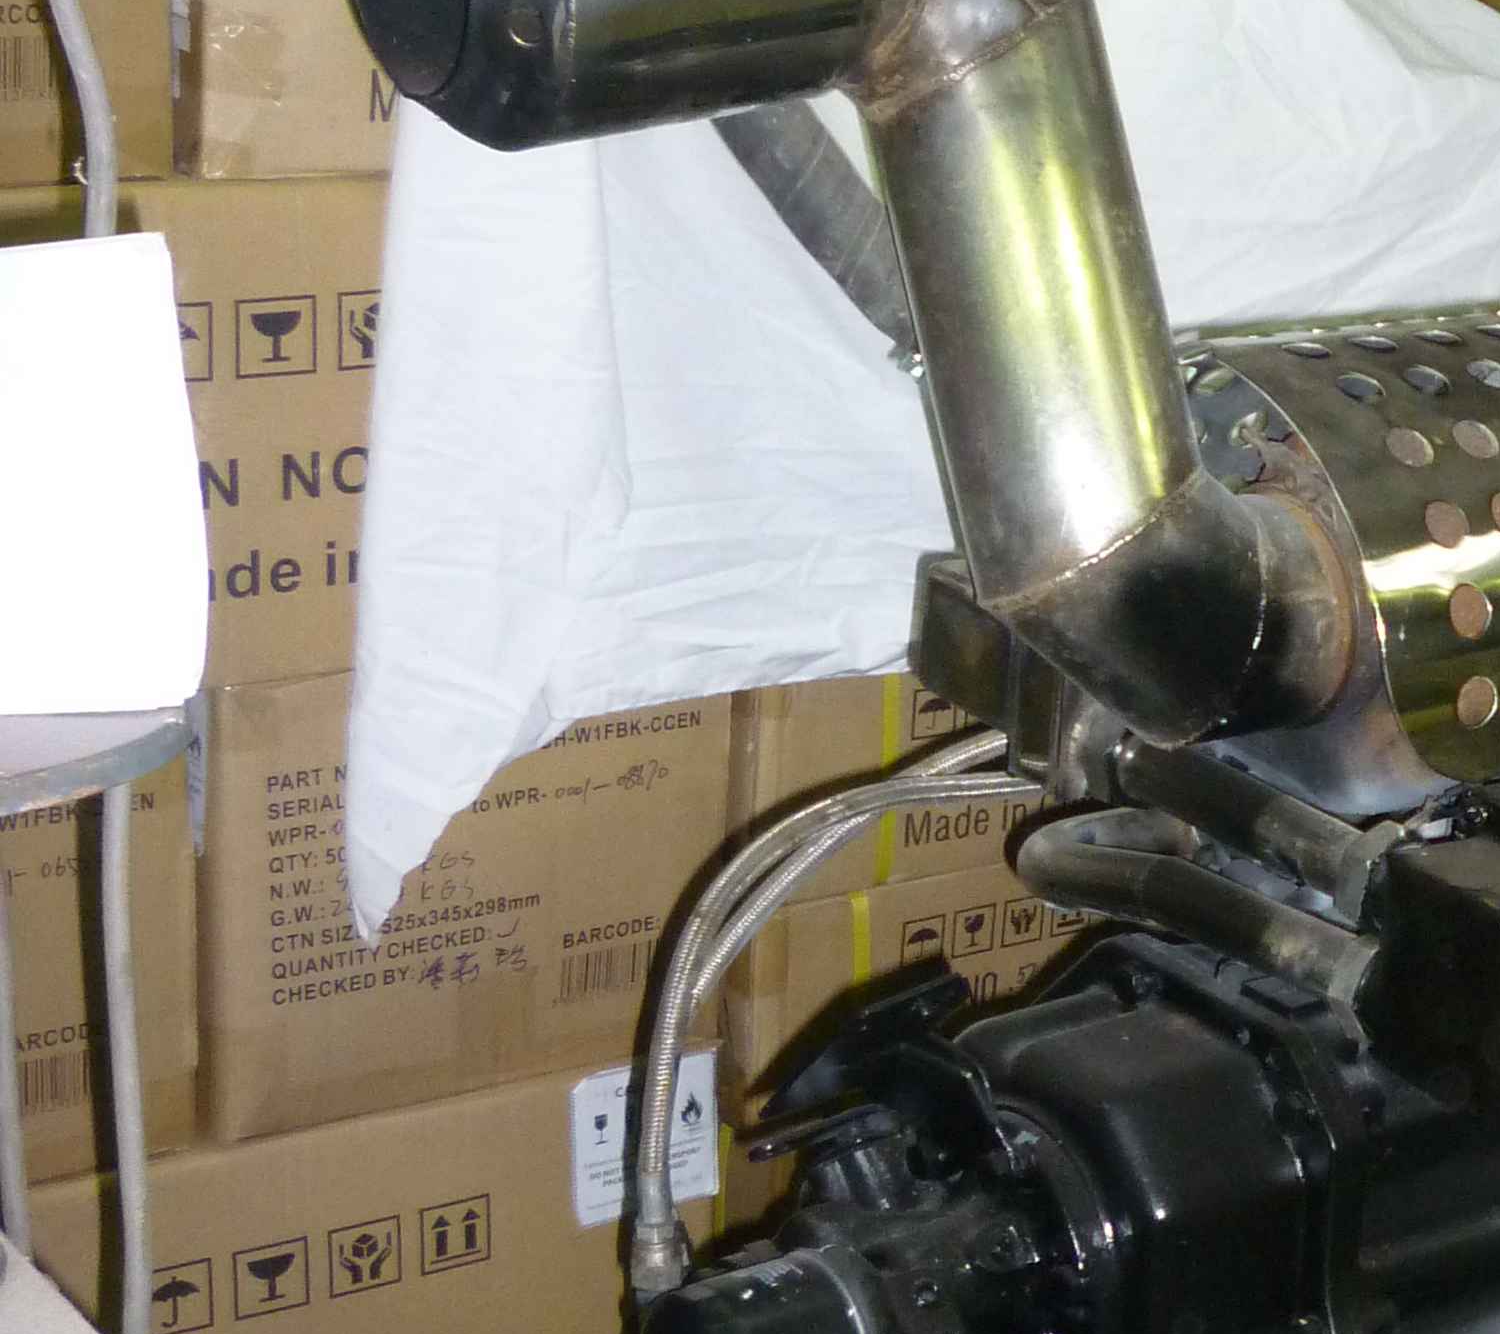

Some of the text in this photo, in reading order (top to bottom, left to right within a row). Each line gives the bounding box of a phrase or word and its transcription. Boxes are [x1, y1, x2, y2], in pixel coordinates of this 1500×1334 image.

[266, 768, 324, 794] PART
[267, 793, 346, 820] SERIAL
[471, 798, 492, 815] to
[903, 803, 990, 848] Made
[269, 851, 318, 874] QTY:
[271, 932, 315, 954] CTN
[321, 924, 362, 946] SIZ
[272, 945, 382, 981] QUANTITY
[272, 971, 377, 1006] CHECKED
